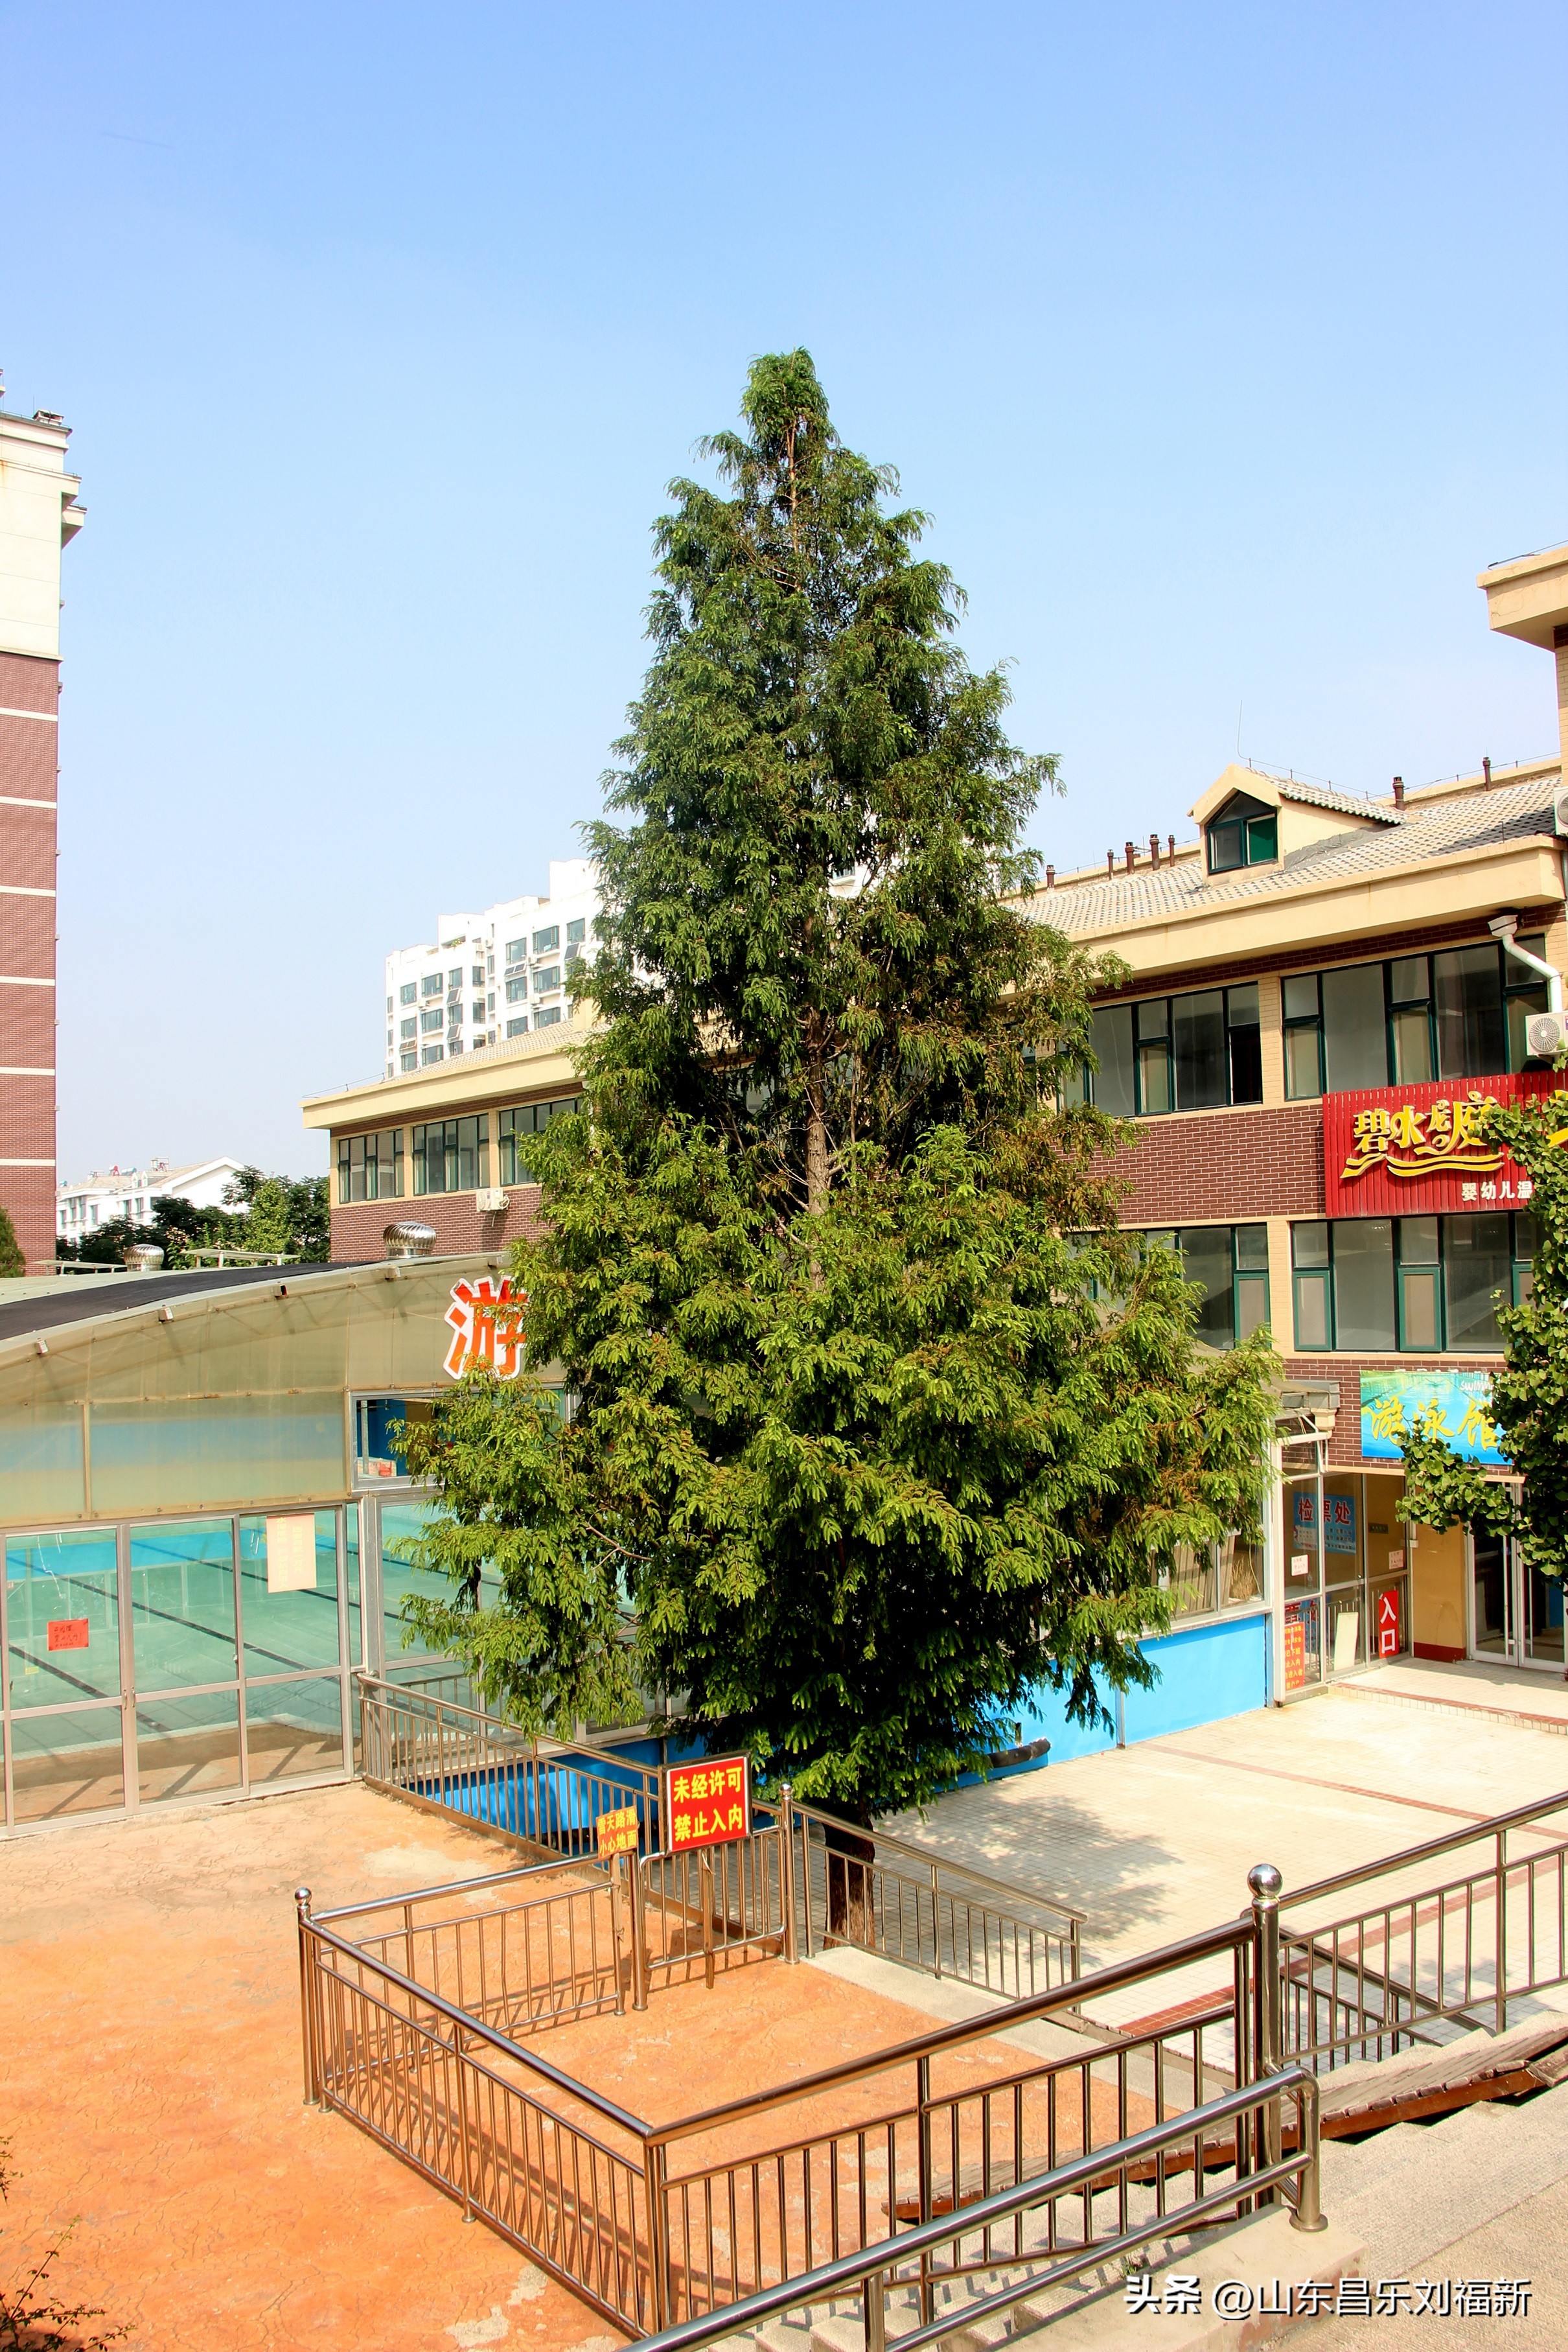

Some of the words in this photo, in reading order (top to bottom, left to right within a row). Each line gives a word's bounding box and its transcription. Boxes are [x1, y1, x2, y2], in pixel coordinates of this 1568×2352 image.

[1461, 1181, 1533, 1201] 婴幼儿温
[443, 1275, 529, 1380] 游
[1361, 1395, 1499, 1451] 游泳馆
[1298, 1497, 1350, 1524] 检票处
[1380, 1596, 1397, 1654] 入口
[673, 1766, 743, 1804] 未经许可
[597, 1808, 636, 1835] 雪天路滑
[674, 1804, 743, 1843] 禁止入内
[599, 1829, 637, 1857] 小心地面
